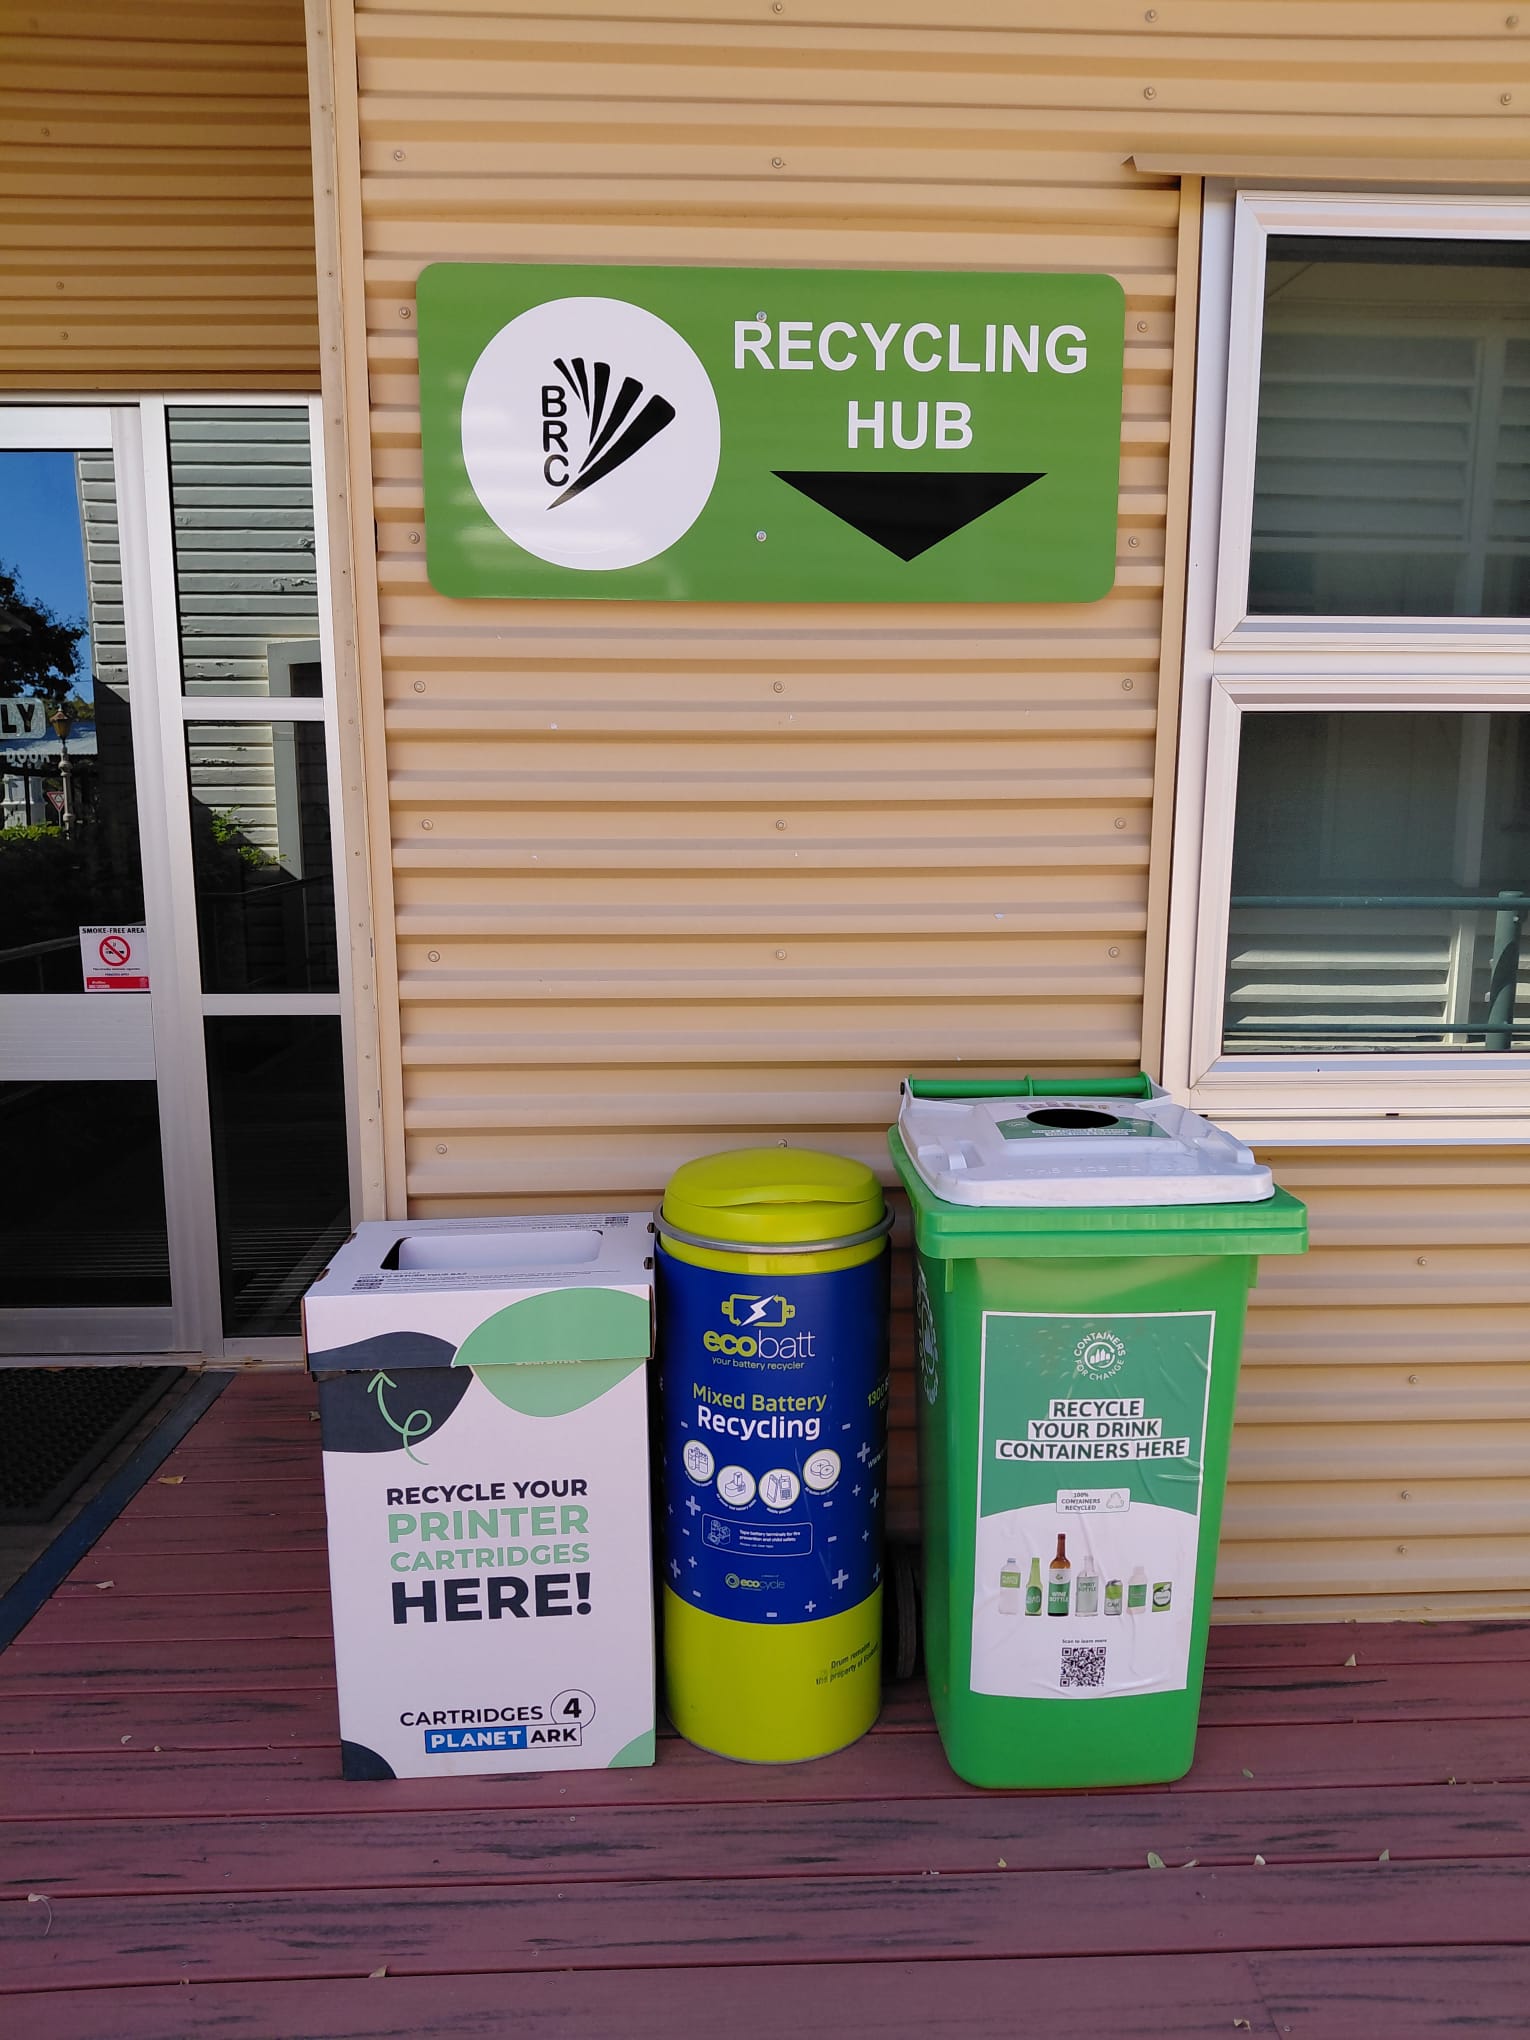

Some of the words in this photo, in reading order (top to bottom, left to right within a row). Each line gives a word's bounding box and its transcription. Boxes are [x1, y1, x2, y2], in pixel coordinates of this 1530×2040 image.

[734, 321, 1088, 374] RECYCLING
[541, 385, 570, 487] BRC
[847, 400, 973, 449] HUB
[703, 1330, 816, 1359] ecobatt
[1073, 1331, 1126, 1357] CONTAINERS
[712, 1356, 731, 1365] your
[732, 1359, 765, 1370] battery
[767, 1361, 805, 1371] recycler
[1073, 1359, 1089, 1376] FOR
[1089, 1359, 1124, 1381] CHANGE
[693, 1382, 745, 1410] Mixed
[752, 1394, 827, 1412] Battery
[1053, 1401, 1140, 1418] RECYCLE
[697, 1405, 821, 1441] Recycling
[1032, 1422, 1089, 1438] YOUR
[1096, 1420, 1159, 1437] DRINK
[1000, 1442, 1129, 1460] CONTAINERS
[1136, 1439, 1186, 1457] HERE
[386, 1483, 506, 1506] RECYCLE
[513, 1479, 588, 1499] YOUR
[388, 1505, 590, 1544] PRINTER
[390, 1543, 590, 1572] CARTRIDGES
[391, 1572, 592, 1625] HERE!
[740, 1579, 785, 1591] ecocycle
[400, 1706, 544, 1726] CARTRIDGES
[563, 1698, 582, 1719] 4
[431, 1730, 522, 1749] PLANET
[530, 1728, 577, 1744] ARK
